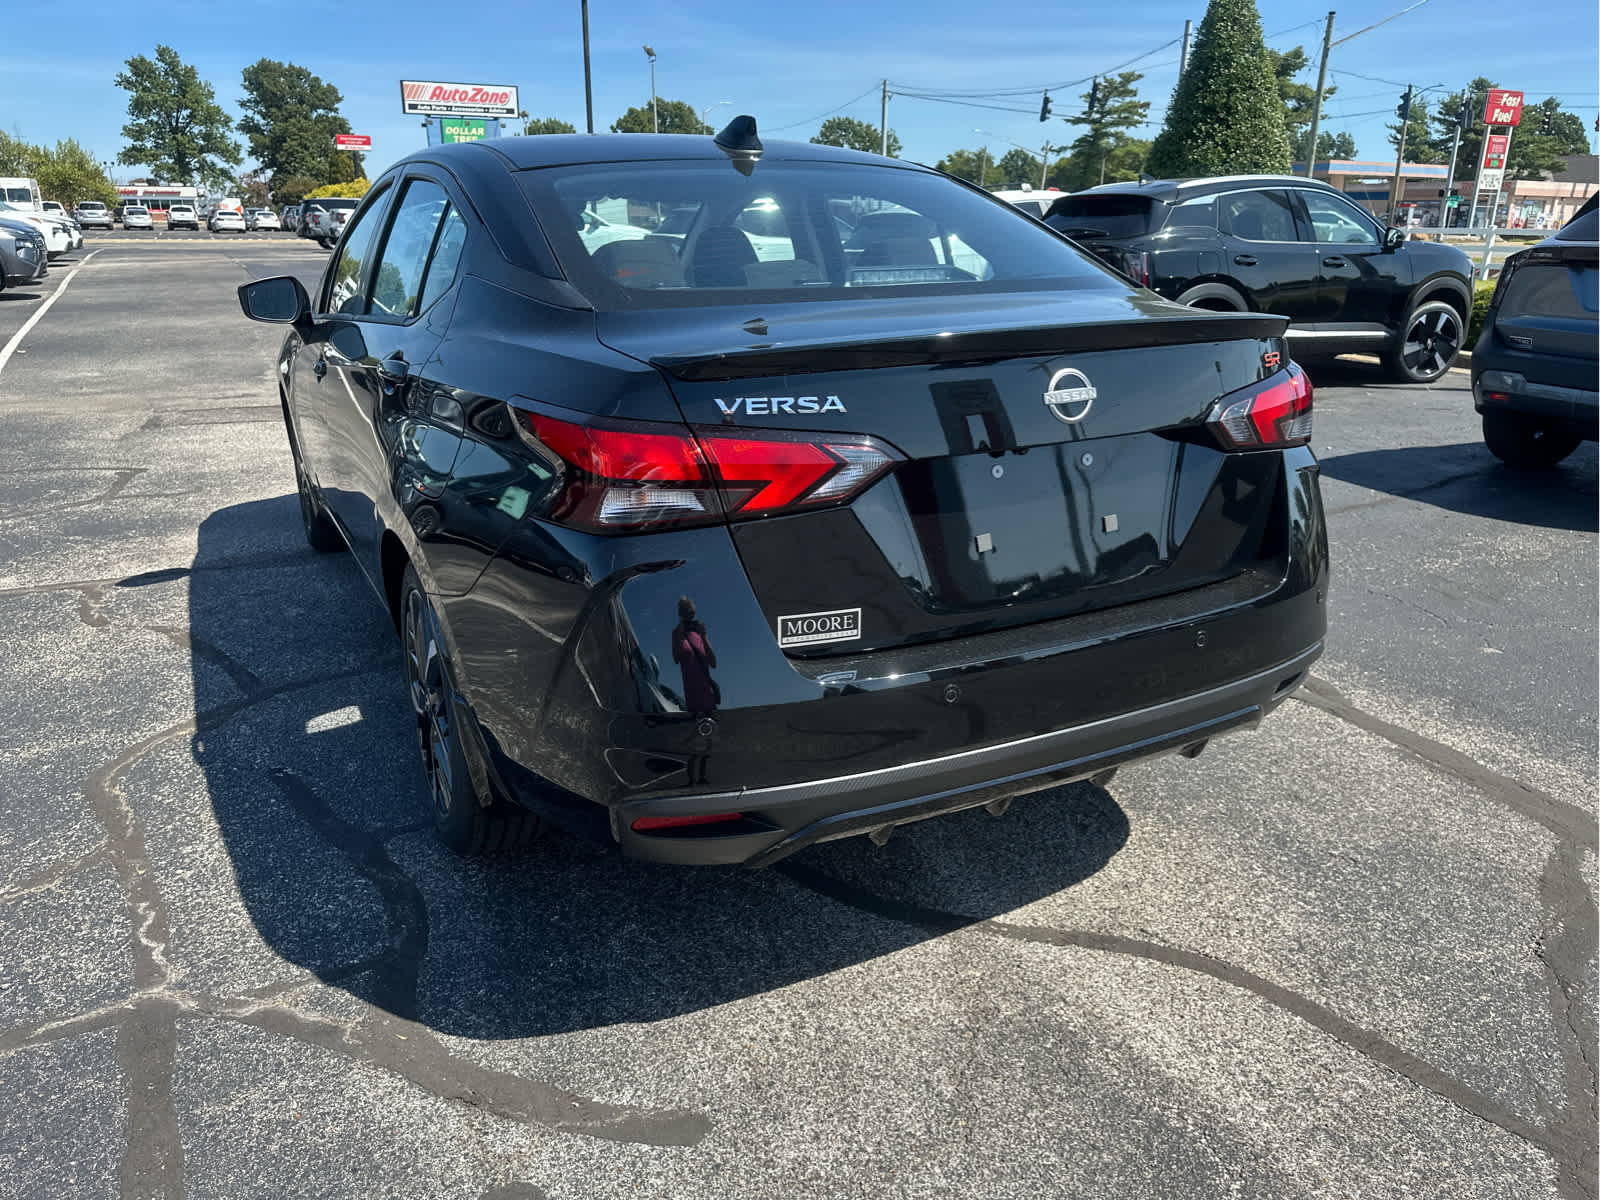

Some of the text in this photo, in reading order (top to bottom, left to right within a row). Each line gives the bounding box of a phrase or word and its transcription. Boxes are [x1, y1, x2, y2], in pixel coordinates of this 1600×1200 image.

[430, 86, 510, 105] AutoZone
[1501, 92, 1521, 107] Fast
[1492, 108, 1514, 122] Fuel
[446, 127, 485, 136] DOLLAR
[1264, 351, 1280, 367] SR
[1046, 389, 1096, 403] NISSAN
[713, 395, 848, 415] VERSA
[786, 614, 855, 635] MOORE
